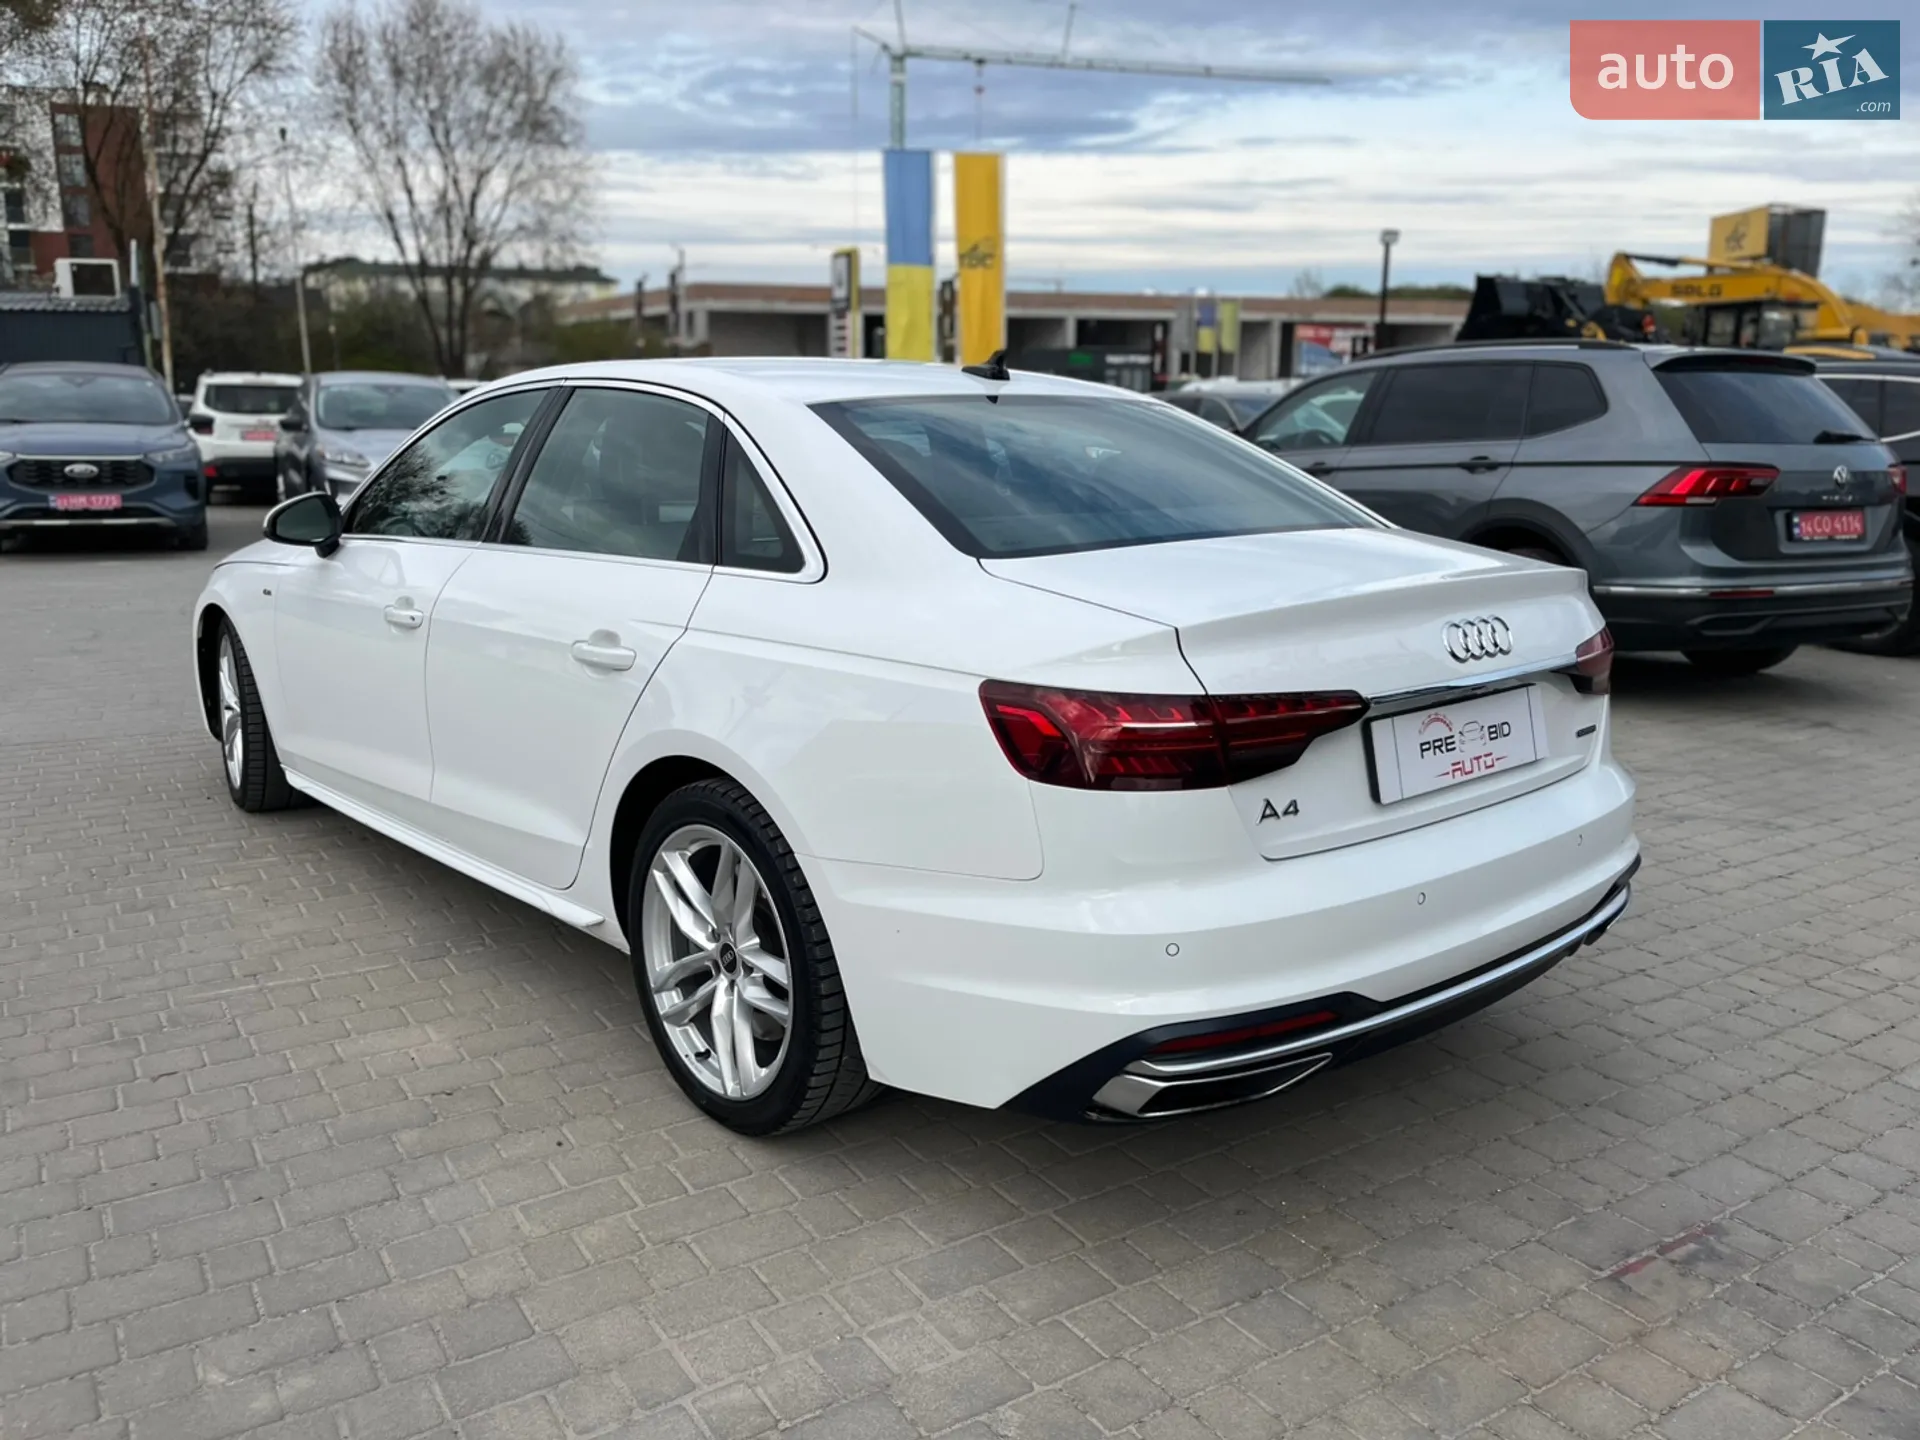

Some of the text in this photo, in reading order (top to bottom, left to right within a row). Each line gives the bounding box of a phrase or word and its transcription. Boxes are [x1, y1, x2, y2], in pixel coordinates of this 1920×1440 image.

[1420, 721, 1511, 759] PRE BID
[1451, 752, 1495, 779] AUTO
[1256, 798, 1300, 826] A4
